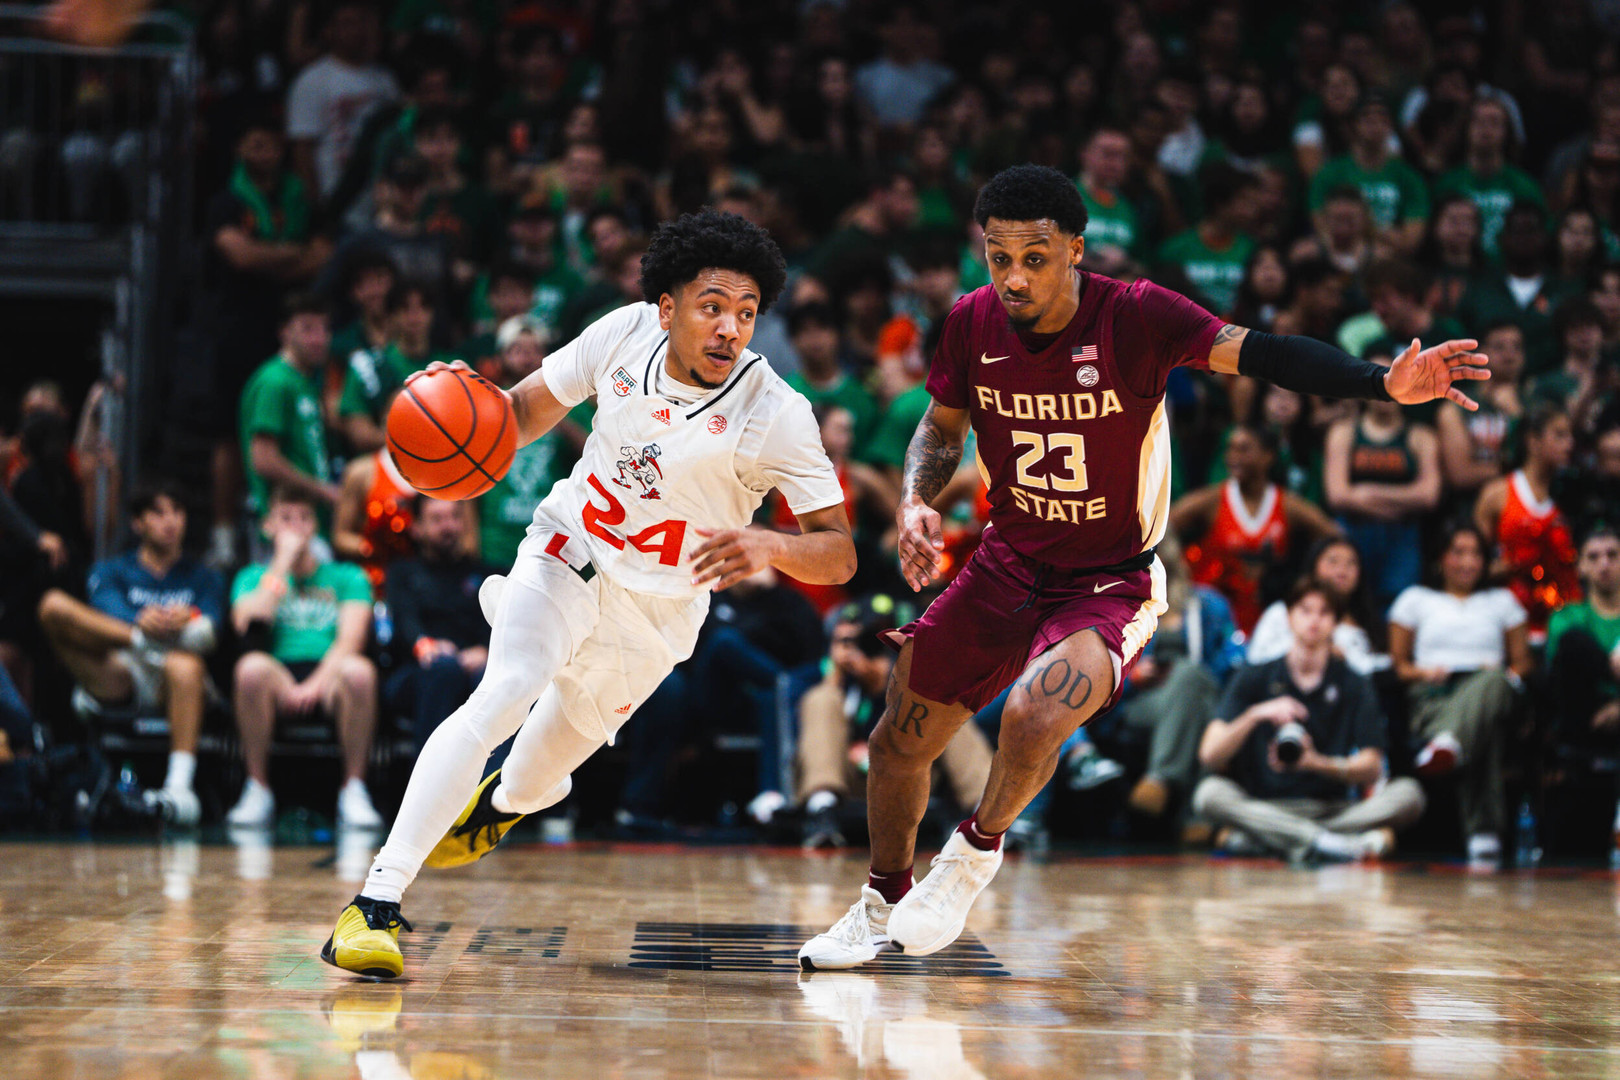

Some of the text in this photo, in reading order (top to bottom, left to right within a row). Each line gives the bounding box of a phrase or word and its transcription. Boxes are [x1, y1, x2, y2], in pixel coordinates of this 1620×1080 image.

[615, 380, 630, 394] 24
[974, 385, 1124, 421] FLORIDA
[629, 459, 642, 471] M
[1011, 430, 1088, 492] 23
[582, 472, 687, 567] 24
[1008, 486, 1107, 525] STATE
